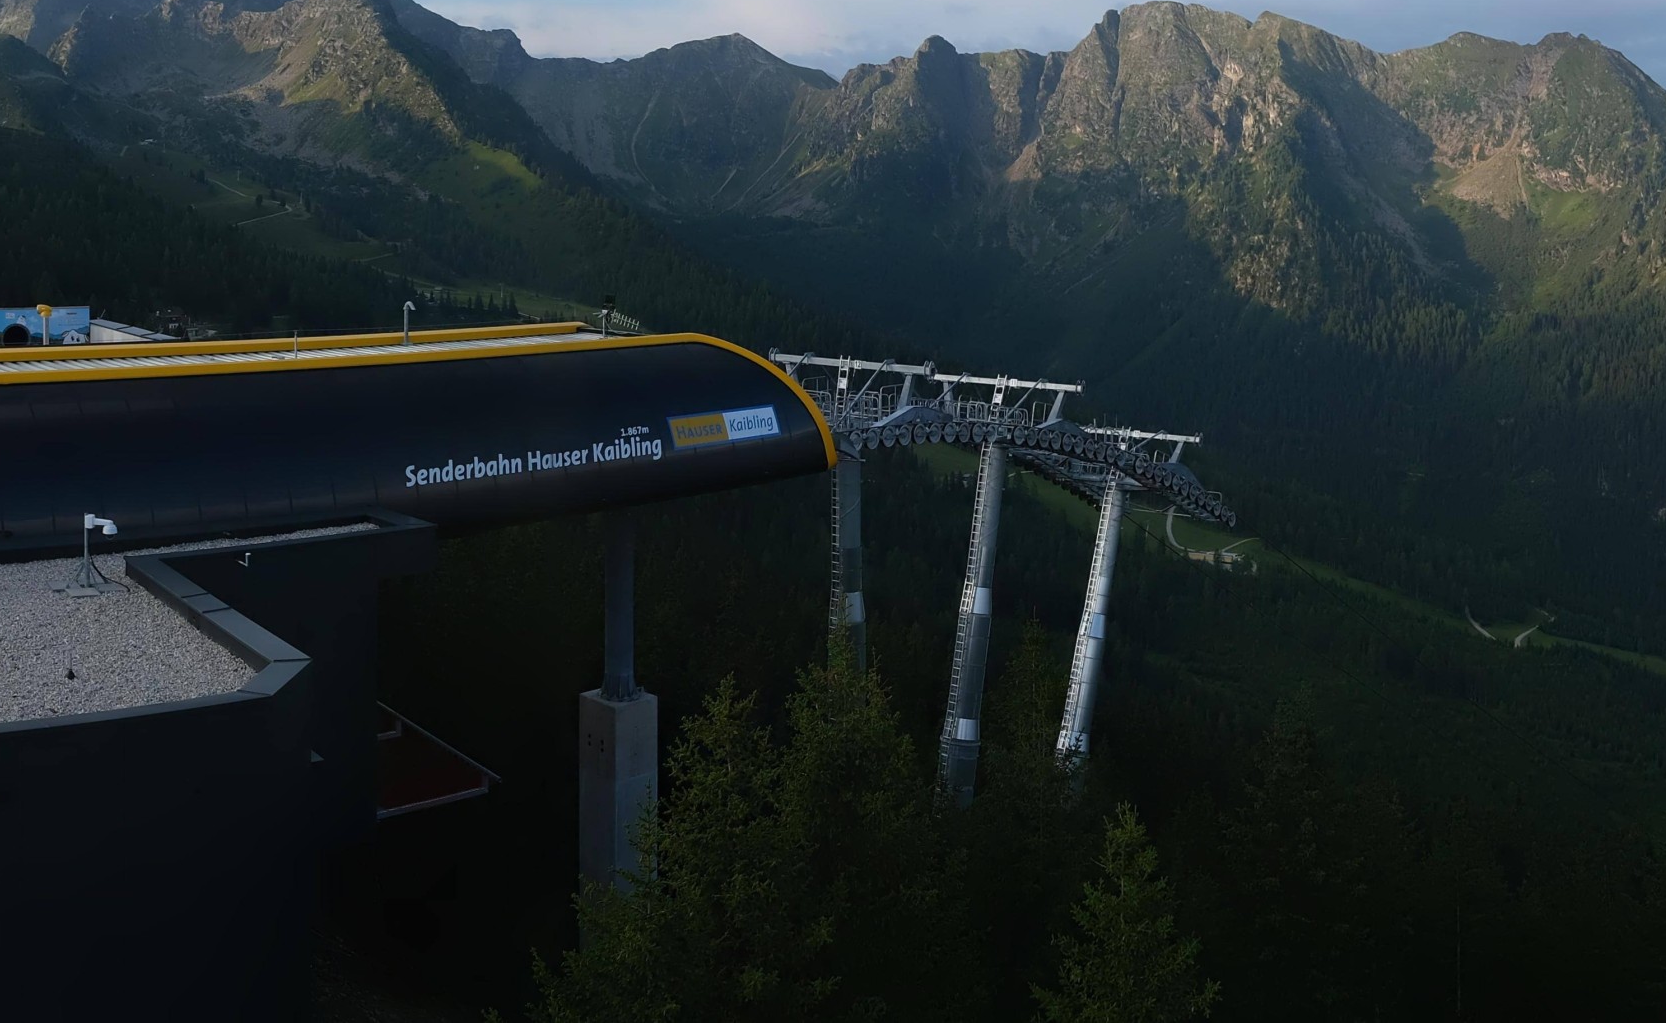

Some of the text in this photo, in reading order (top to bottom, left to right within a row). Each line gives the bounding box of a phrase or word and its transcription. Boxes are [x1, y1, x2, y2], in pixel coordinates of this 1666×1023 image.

[620, 426, 650, 437] 1.867m
[675, 413, 774, 440] HAUSER Kaibling
[405, 436, 663, 487] Senderbahn Hauser Kaibling
